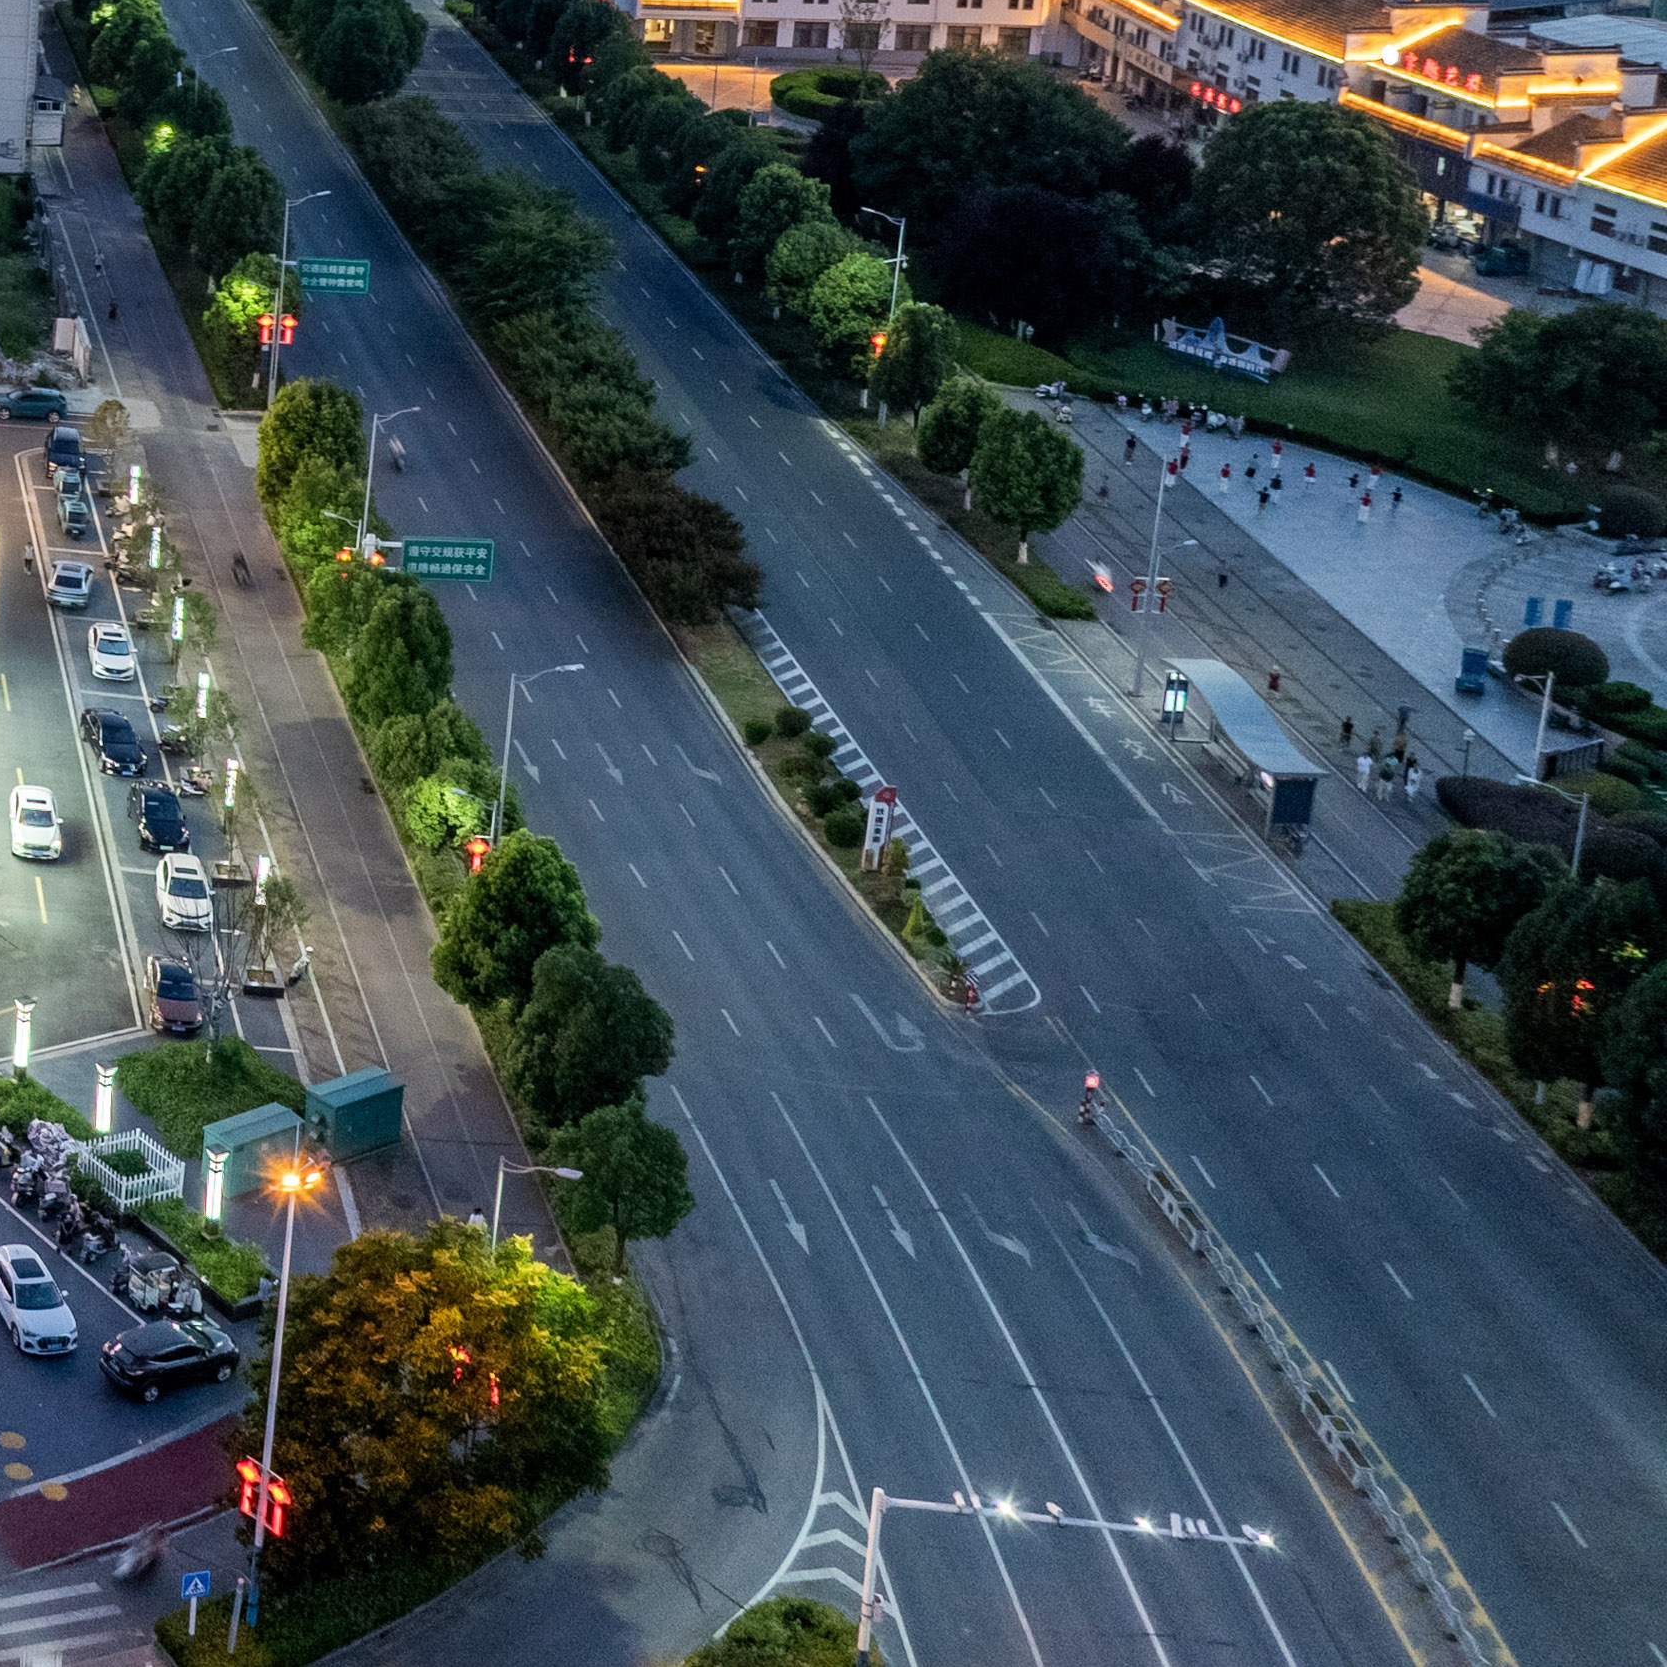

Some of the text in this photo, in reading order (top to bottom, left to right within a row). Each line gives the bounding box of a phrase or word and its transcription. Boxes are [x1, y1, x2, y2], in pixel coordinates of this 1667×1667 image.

[408, 546, 488, 559] 遵守交规获平安
